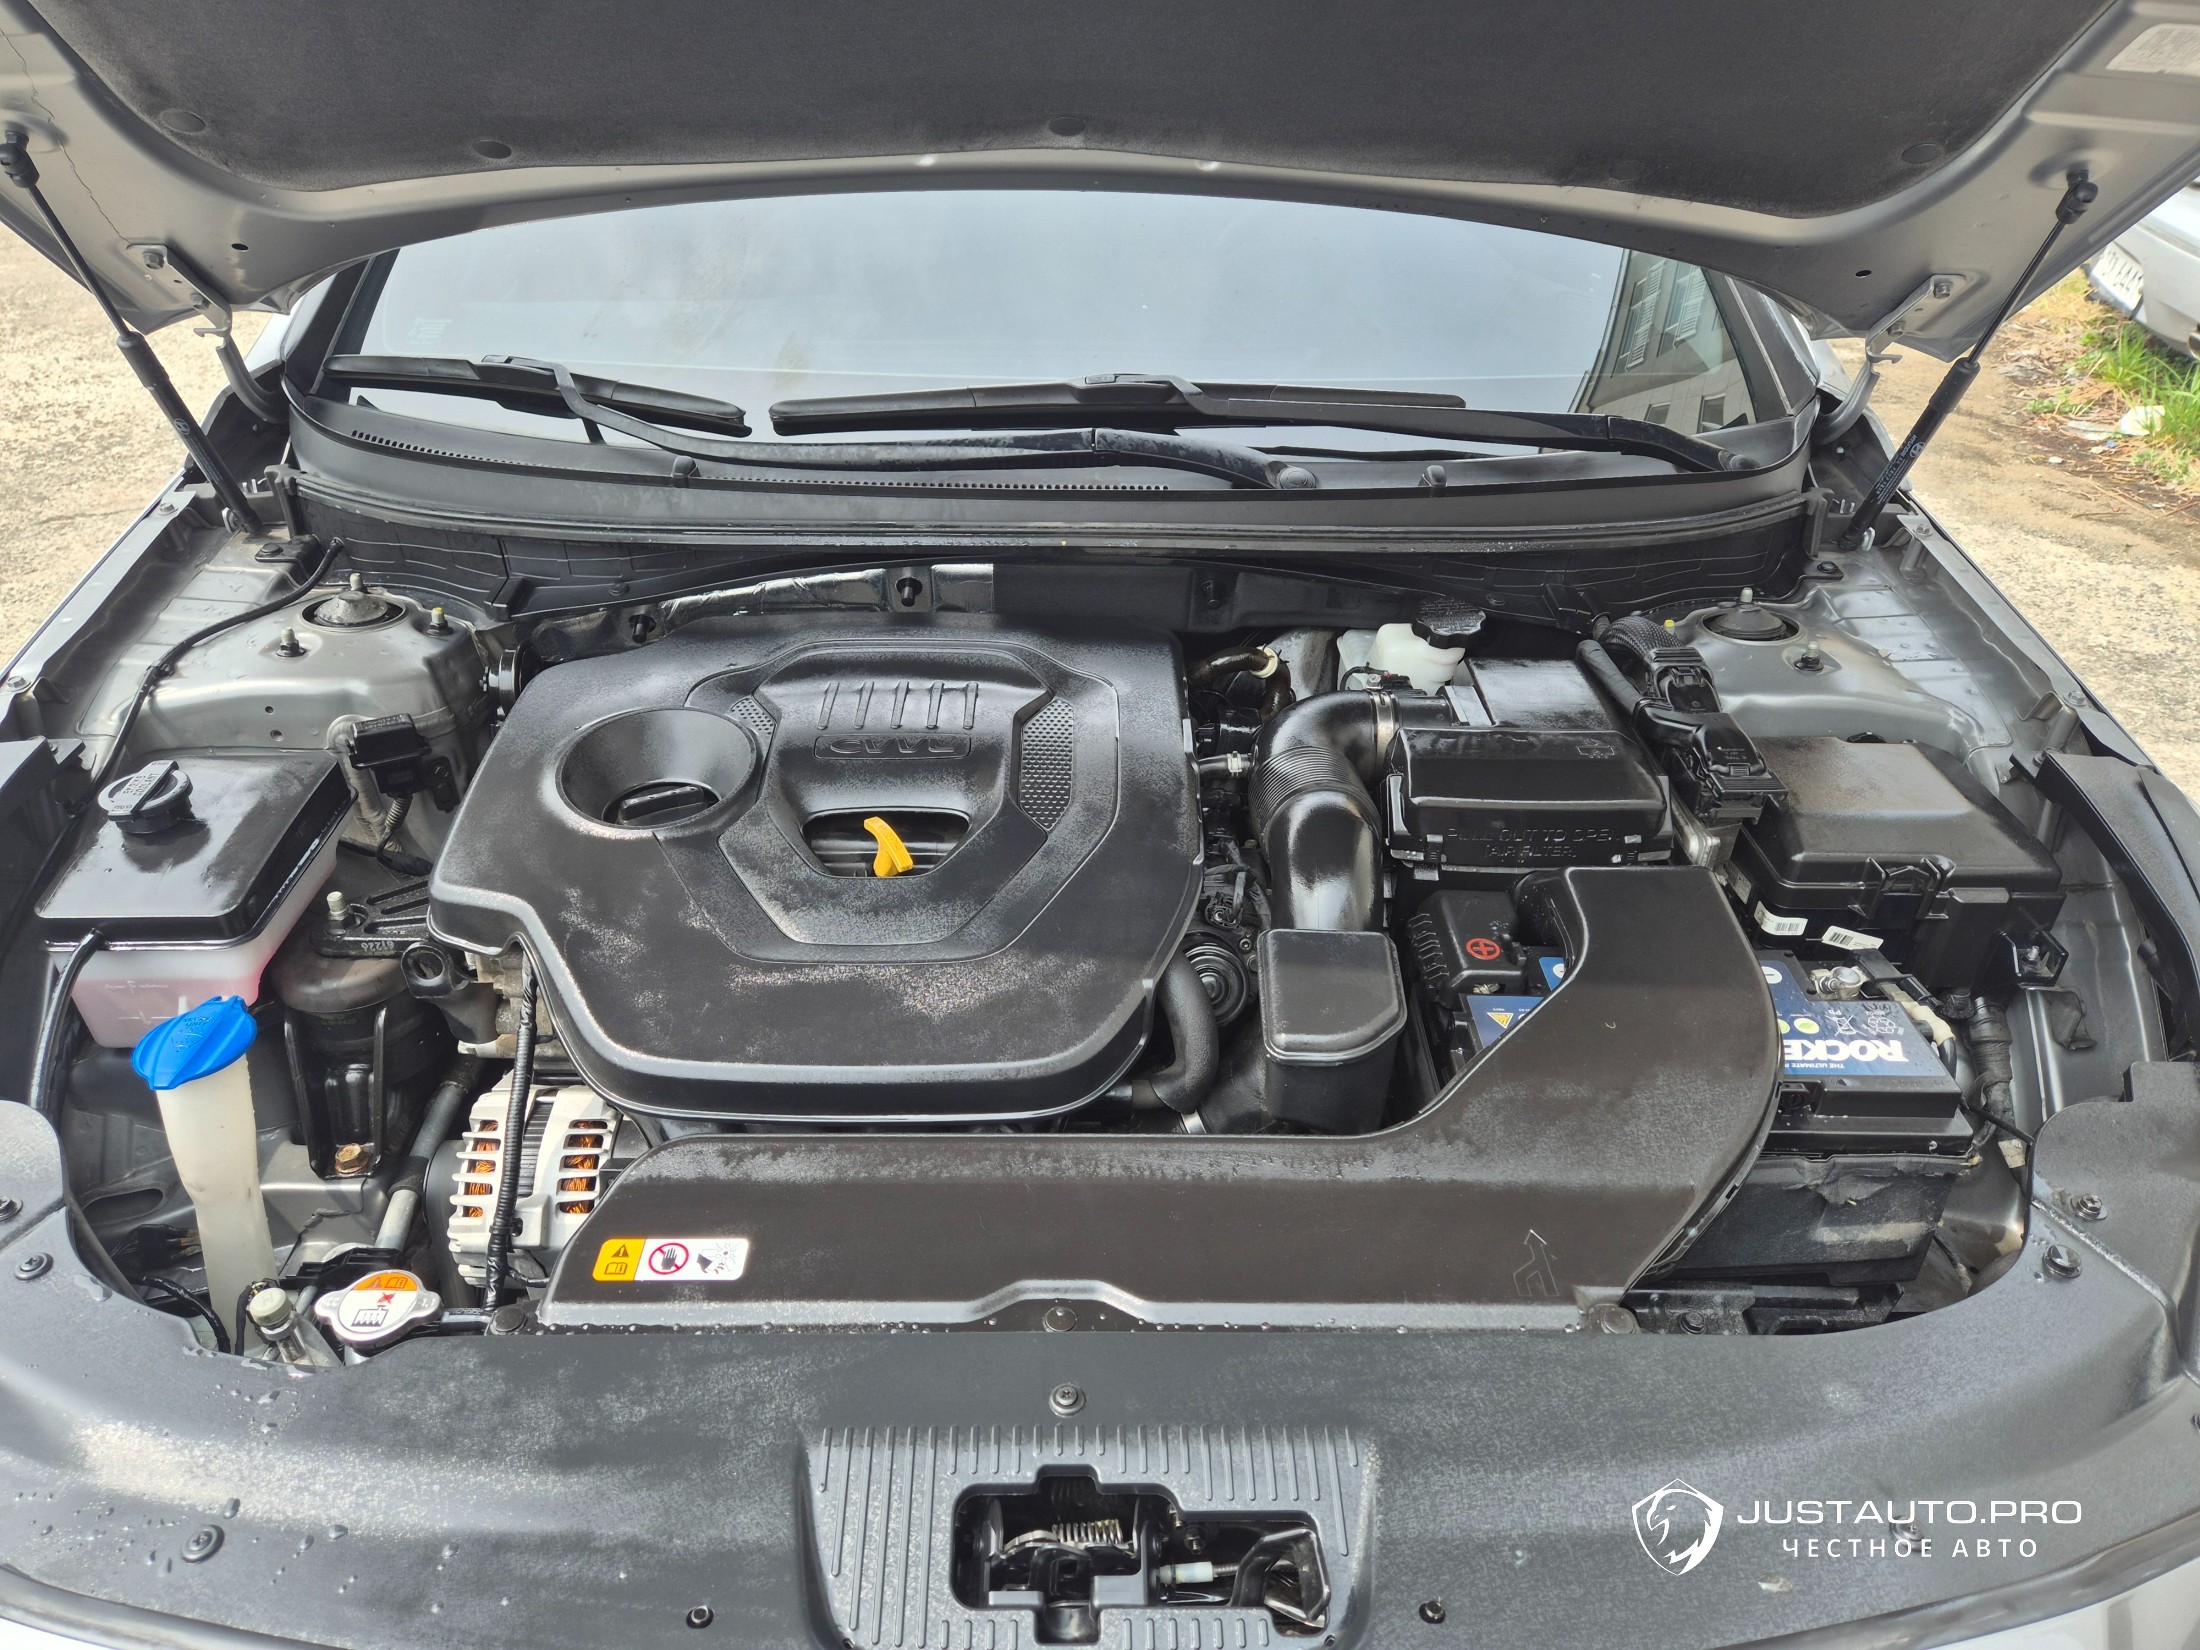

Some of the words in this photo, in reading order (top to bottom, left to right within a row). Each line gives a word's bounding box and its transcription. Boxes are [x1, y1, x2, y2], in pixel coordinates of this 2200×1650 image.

[1901, 434, 1918, 458] HYUNDAI
[829, 737, 956, 754] CVVL
[1499, 829, 1539, 842] OUT
[1542, 829, 1566, 842] TO
[1783, 1039, 1909, 1062] ROCKE
[420, 1297, 436, 1308] 1.1
